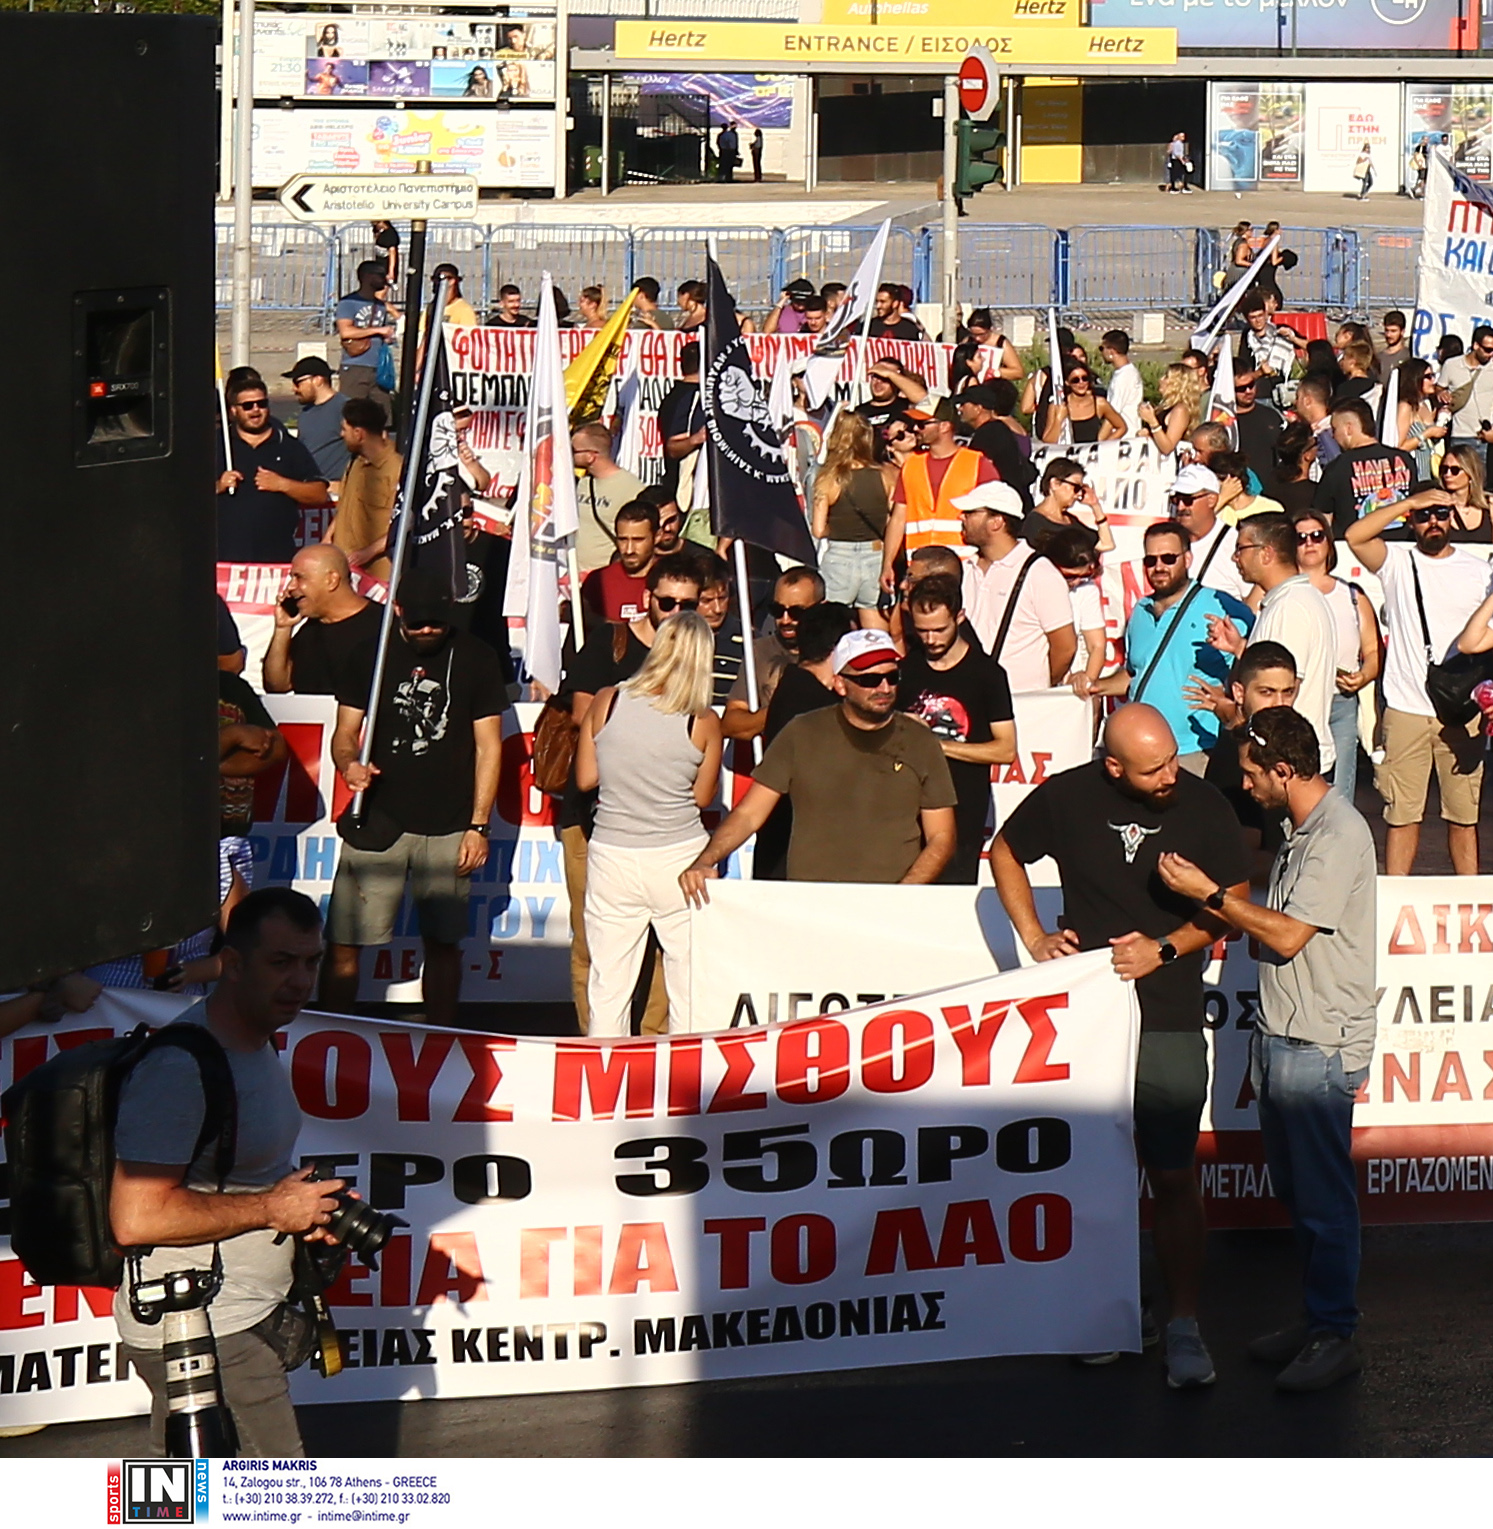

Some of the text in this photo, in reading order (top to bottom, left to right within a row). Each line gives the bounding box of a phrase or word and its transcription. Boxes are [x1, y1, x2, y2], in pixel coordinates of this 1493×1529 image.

[649, 29, 708, 49] Hertz
[784, 35, 899, 53] ENTRANCE
[1087, 34, 1146, 54] Hertz
[1348, 114, 1373, 123] ΕΔΩ
[1348, 125, 1380, 134] ΣΤΗΝ
[324, 182, 474, 196] Αριστοτέλειο Πανεπιστήμιο
[324, 200, 473, 213] Aristotelio University Campus
[1352, 455, 1406, 477] HAVE A
[1384, 469, 1411, 490] DAY
[551, 991, 1072, 1123] ΜΙΣΘΟΥΣ
[612, 1116, 1073, 1197] 35ΩΡΟ
[1200, 1162, 1276, 1199] ΜΕΤΑΛ
[520, 1191, 1074, 1299] ΓΙΑ ΤΟ ΛΑΟ
[452, 1290, 947, 1364] ΚΕΝΤΡ. ΜΑΚΕΔΟΝΙΑΣ
